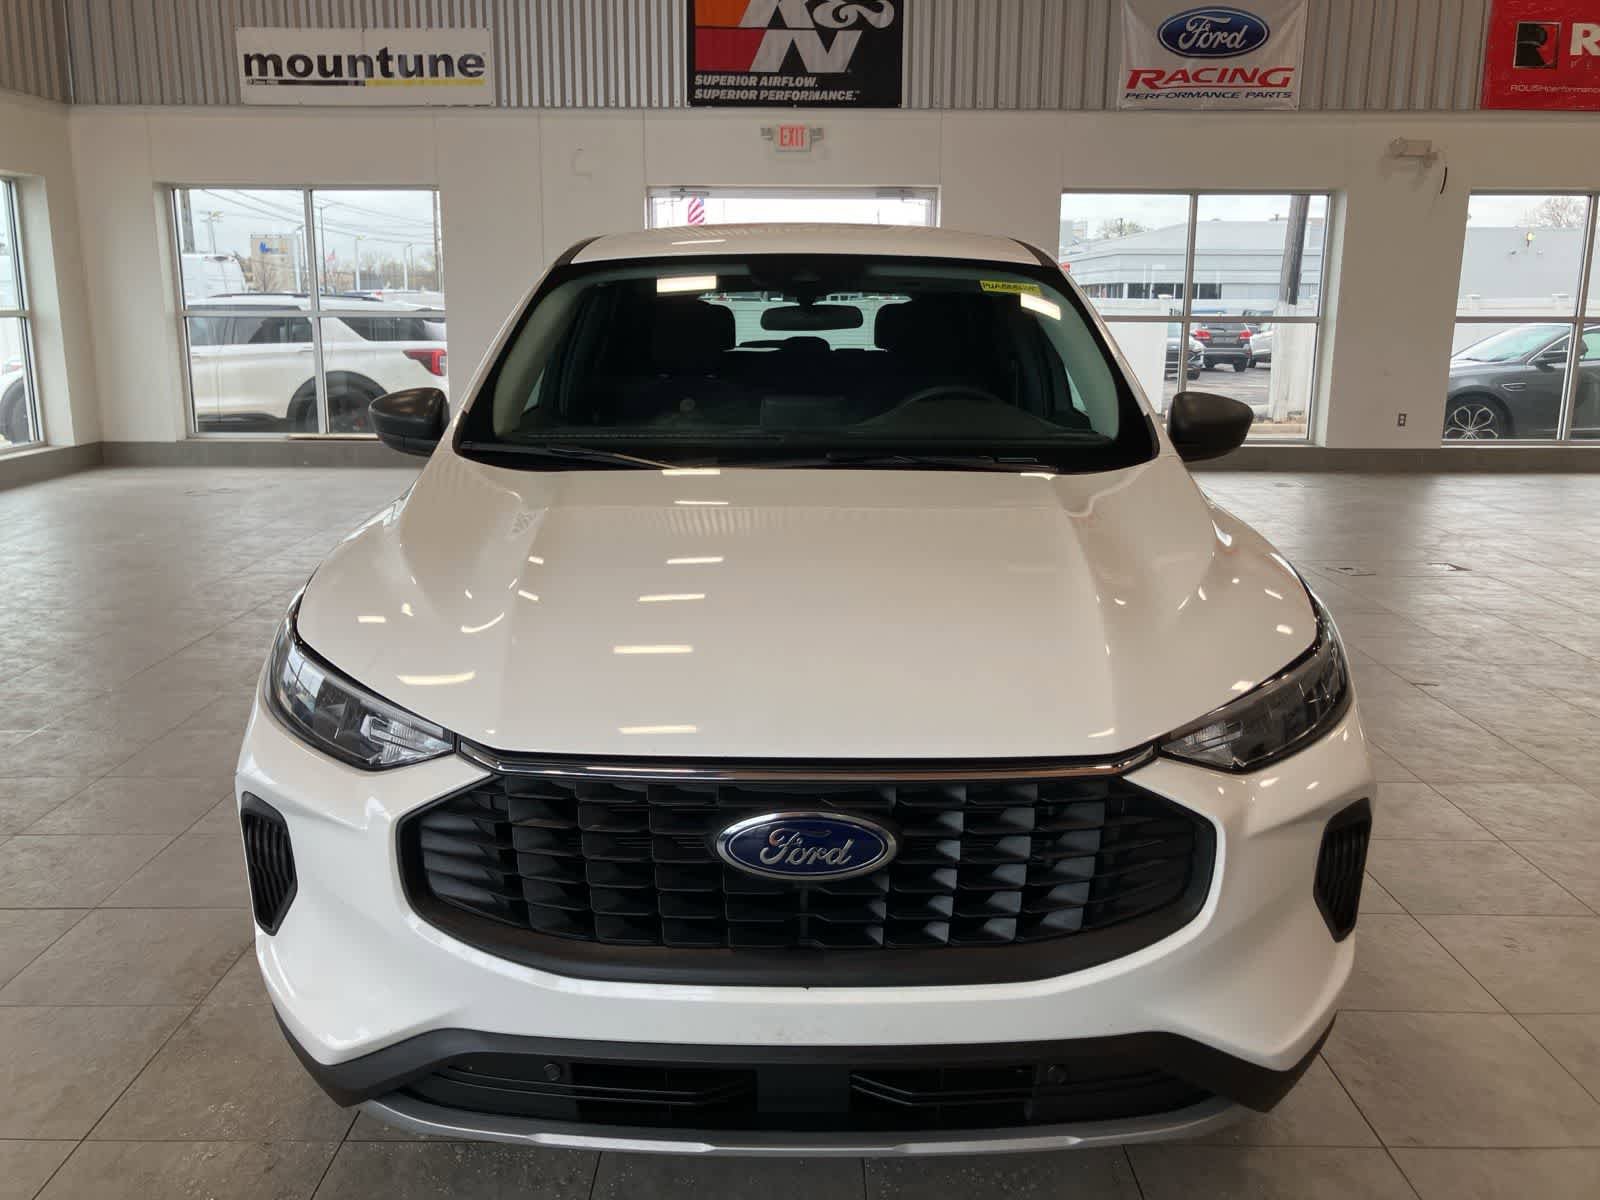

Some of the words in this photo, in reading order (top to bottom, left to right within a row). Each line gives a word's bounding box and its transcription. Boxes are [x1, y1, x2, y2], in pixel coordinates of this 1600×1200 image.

[1178, 15, 1249, 50] Ford
[243, 47, 485, 78] mountune
[694, 74, 758, 86] SUPERIOR
[759, 76, 819, 88] AIRFLOW.
[1126, 67, 1295, 90] RACING
[694, 88, 757, 100] SUPERIOR
[1125, 91, 1241, 99] PERFORMANCE
[1245, 91, 1292, 99] PARTS
[779, 126, 805, 147] EXIT
[759, 827, 855, 866] Ford
